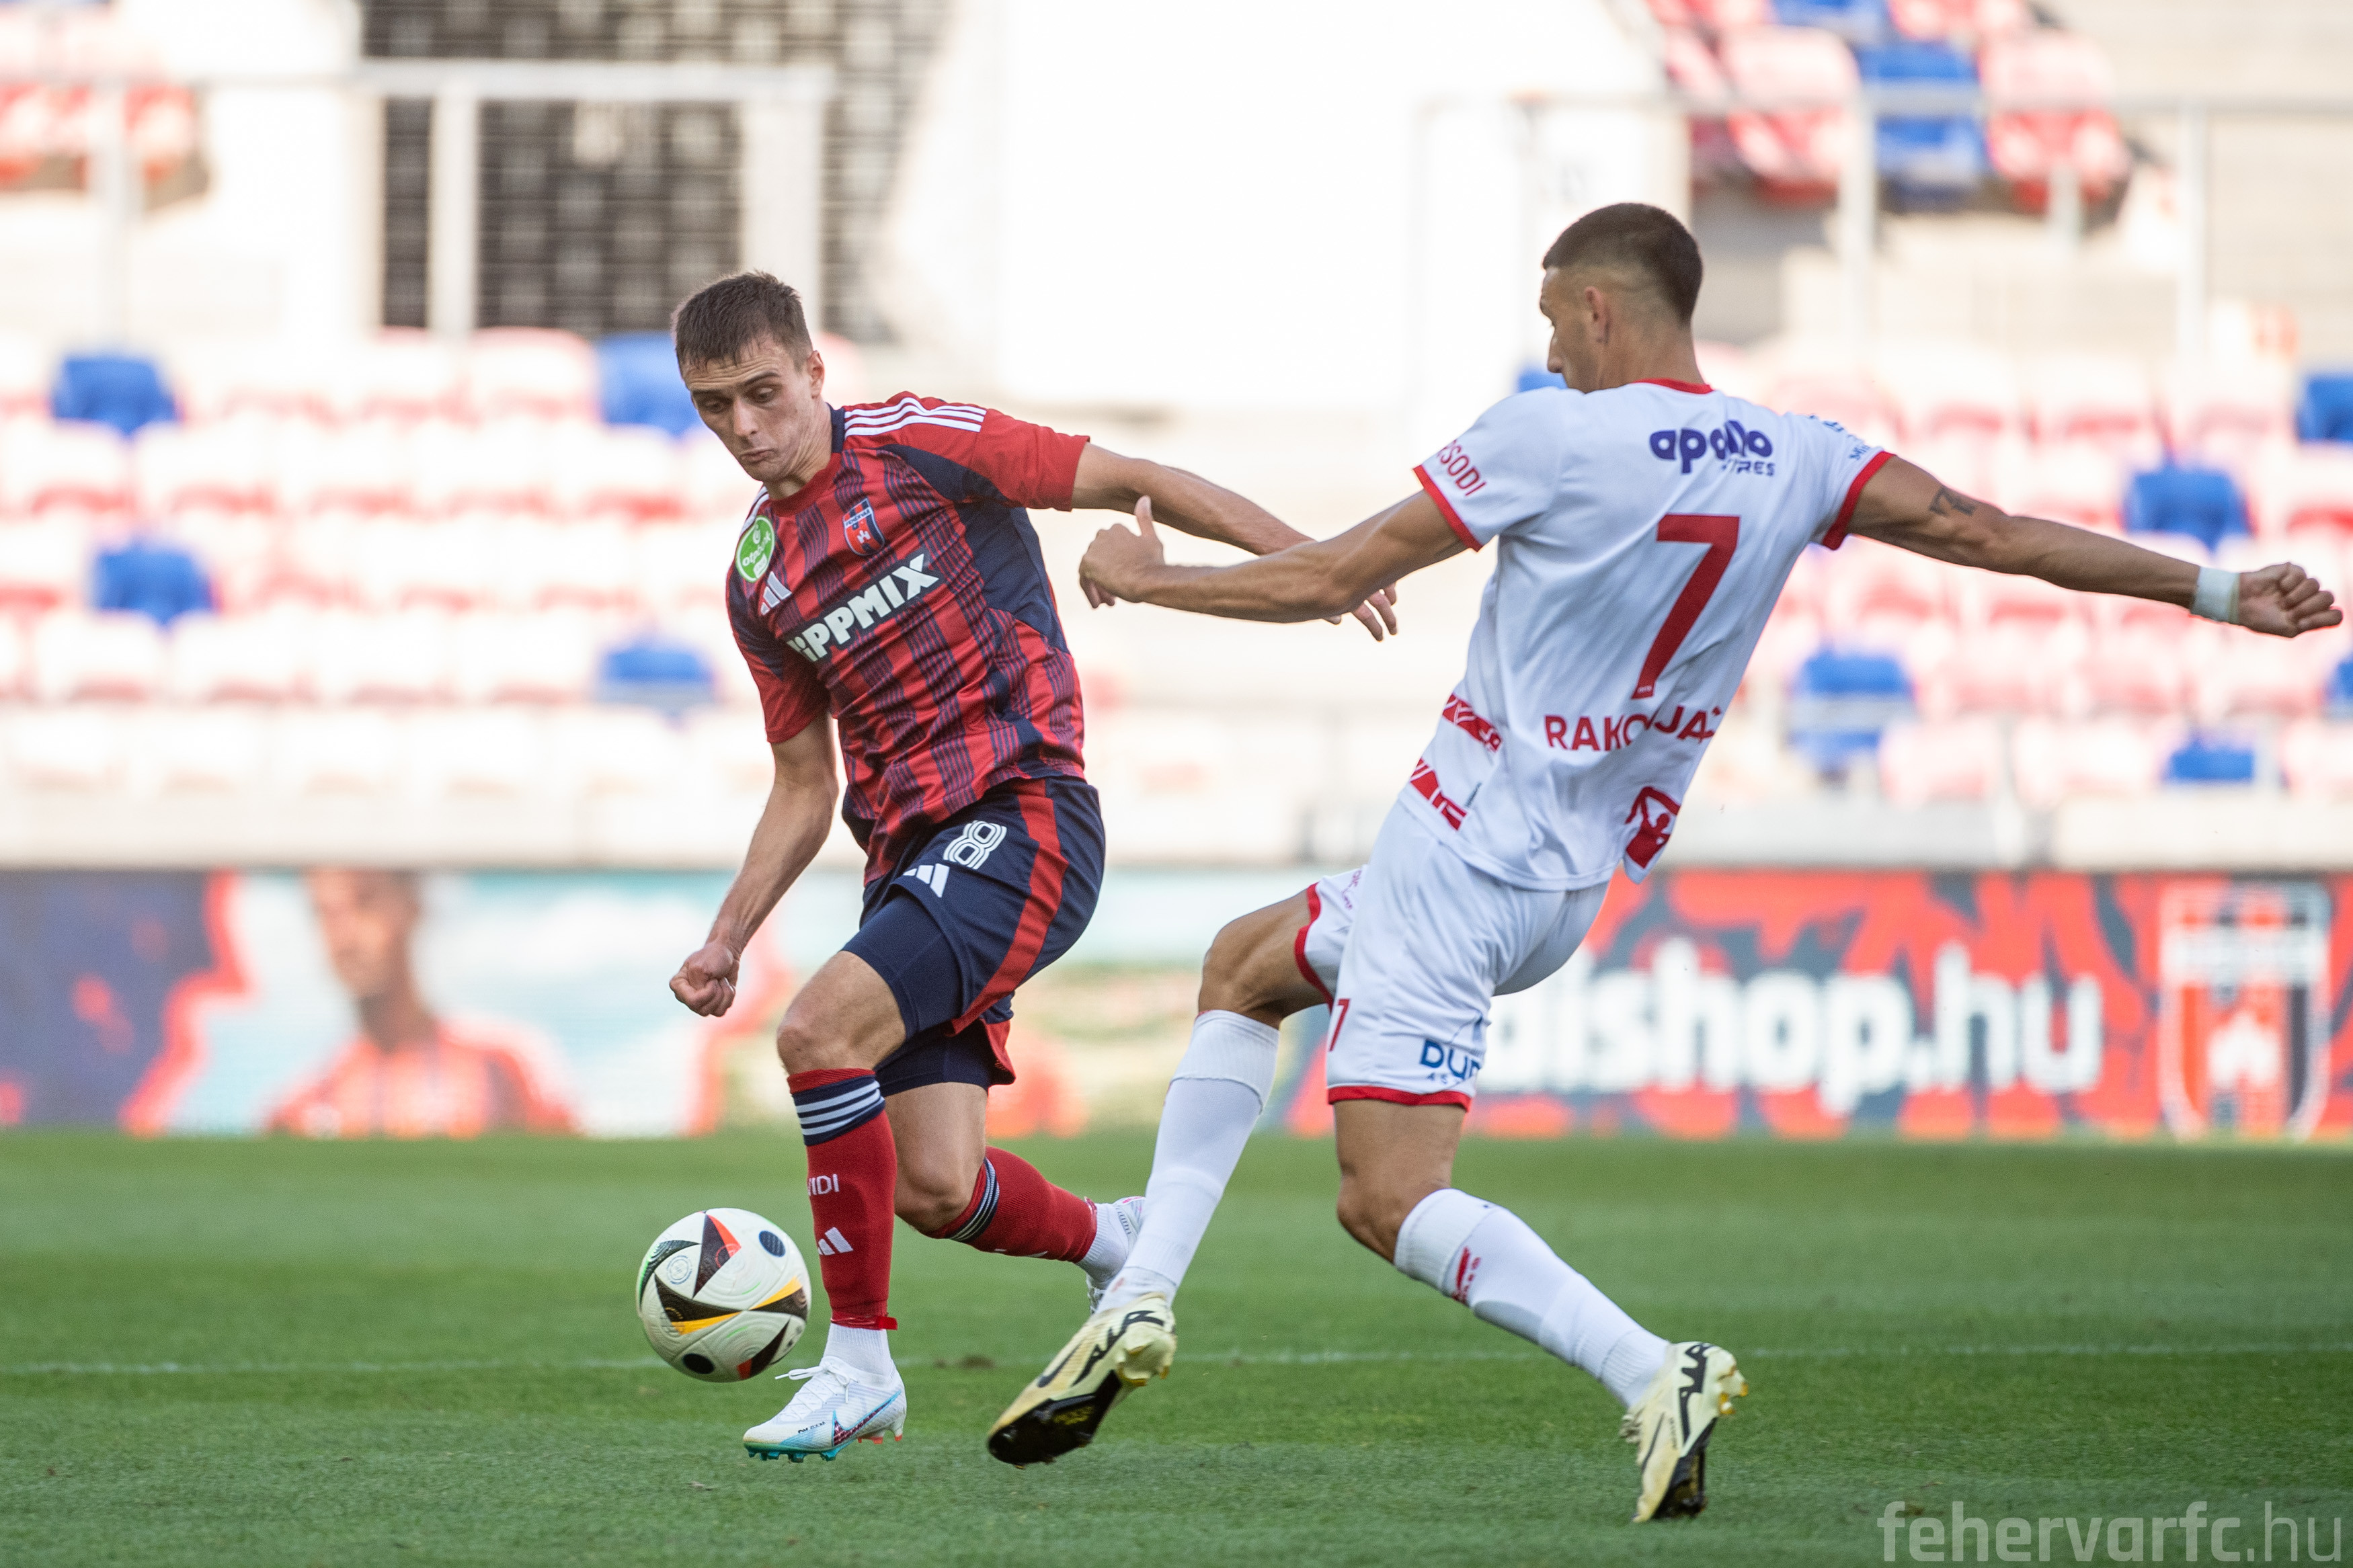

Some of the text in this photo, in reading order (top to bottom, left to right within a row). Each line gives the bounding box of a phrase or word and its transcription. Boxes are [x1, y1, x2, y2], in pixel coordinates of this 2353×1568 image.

[1630, 513, 1740, 700] 7
[943, 819, 1008, 870] 8
[1329, 998, 1351, 1053] 7
